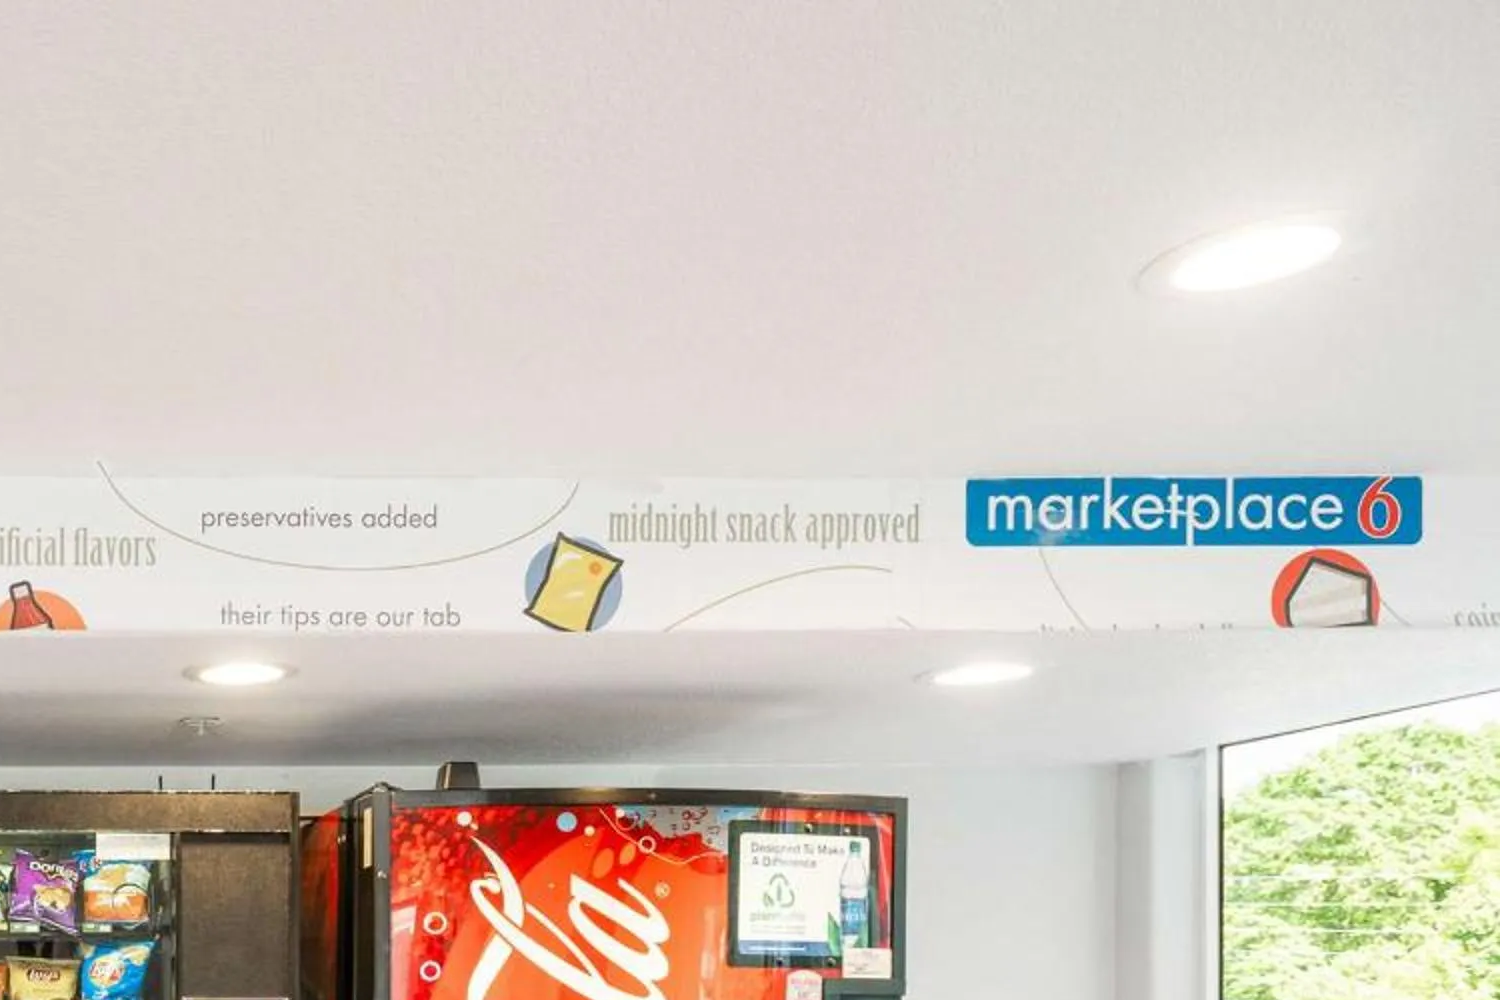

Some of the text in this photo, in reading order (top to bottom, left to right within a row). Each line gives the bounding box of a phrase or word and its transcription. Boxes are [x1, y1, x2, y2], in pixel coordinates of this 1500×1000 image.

[202, 504, 437, 534] preservatives added
[609, 501, 920, 546] midnight snack approved
[988, 477, 1343, 544] marketplace
[74, 528, 158, 567] flavors
[221, 602, 460, 631] their tips are our tab
